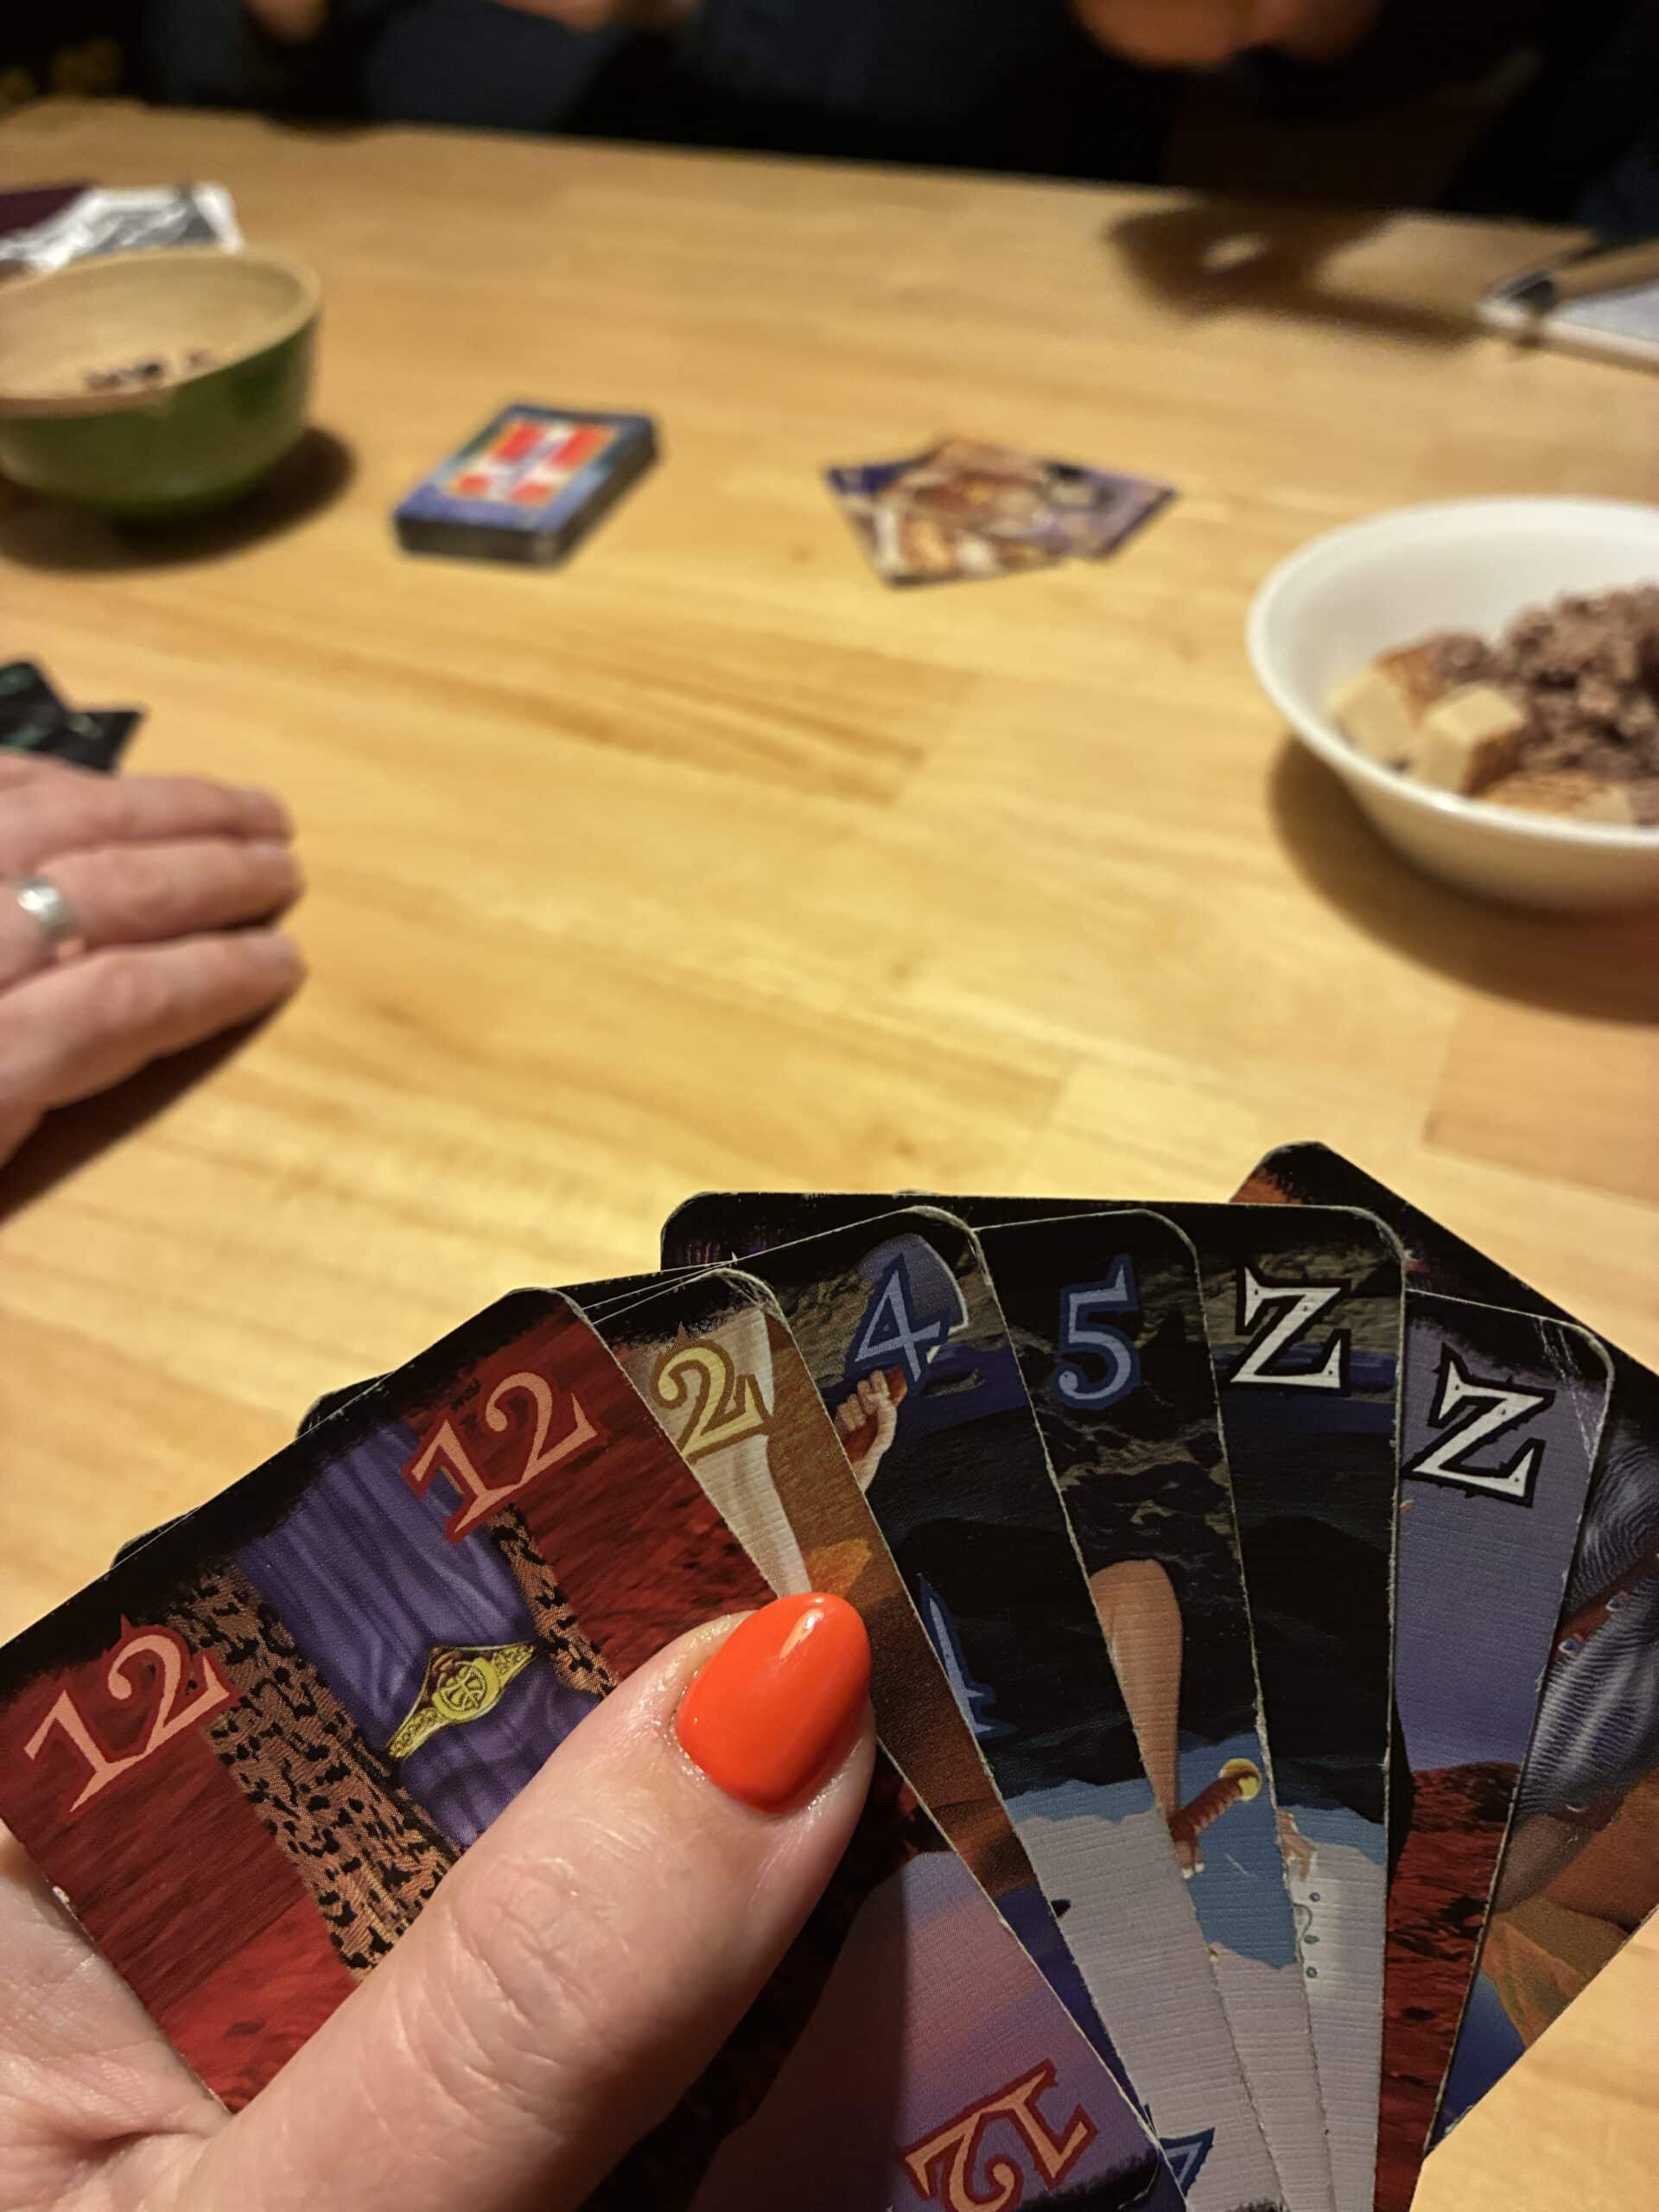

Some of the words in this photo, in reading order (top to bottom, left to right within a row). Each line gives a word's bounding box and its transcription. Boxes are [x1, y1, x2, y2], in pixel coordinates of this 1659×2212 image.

[850, 1260, 944, 1386] 4
[1055, 1255, 1139, 1407] 5
[1229, 1263, 1350, 1391] Z
[408, 1370, 600, 1536] 12
[655, 1342, 771, 1460] 2
[1408, 1351, 1548, 1500] Z
[22, 1631, 232, 1813] 12
[900, 2062, 1097, 2212] 12
